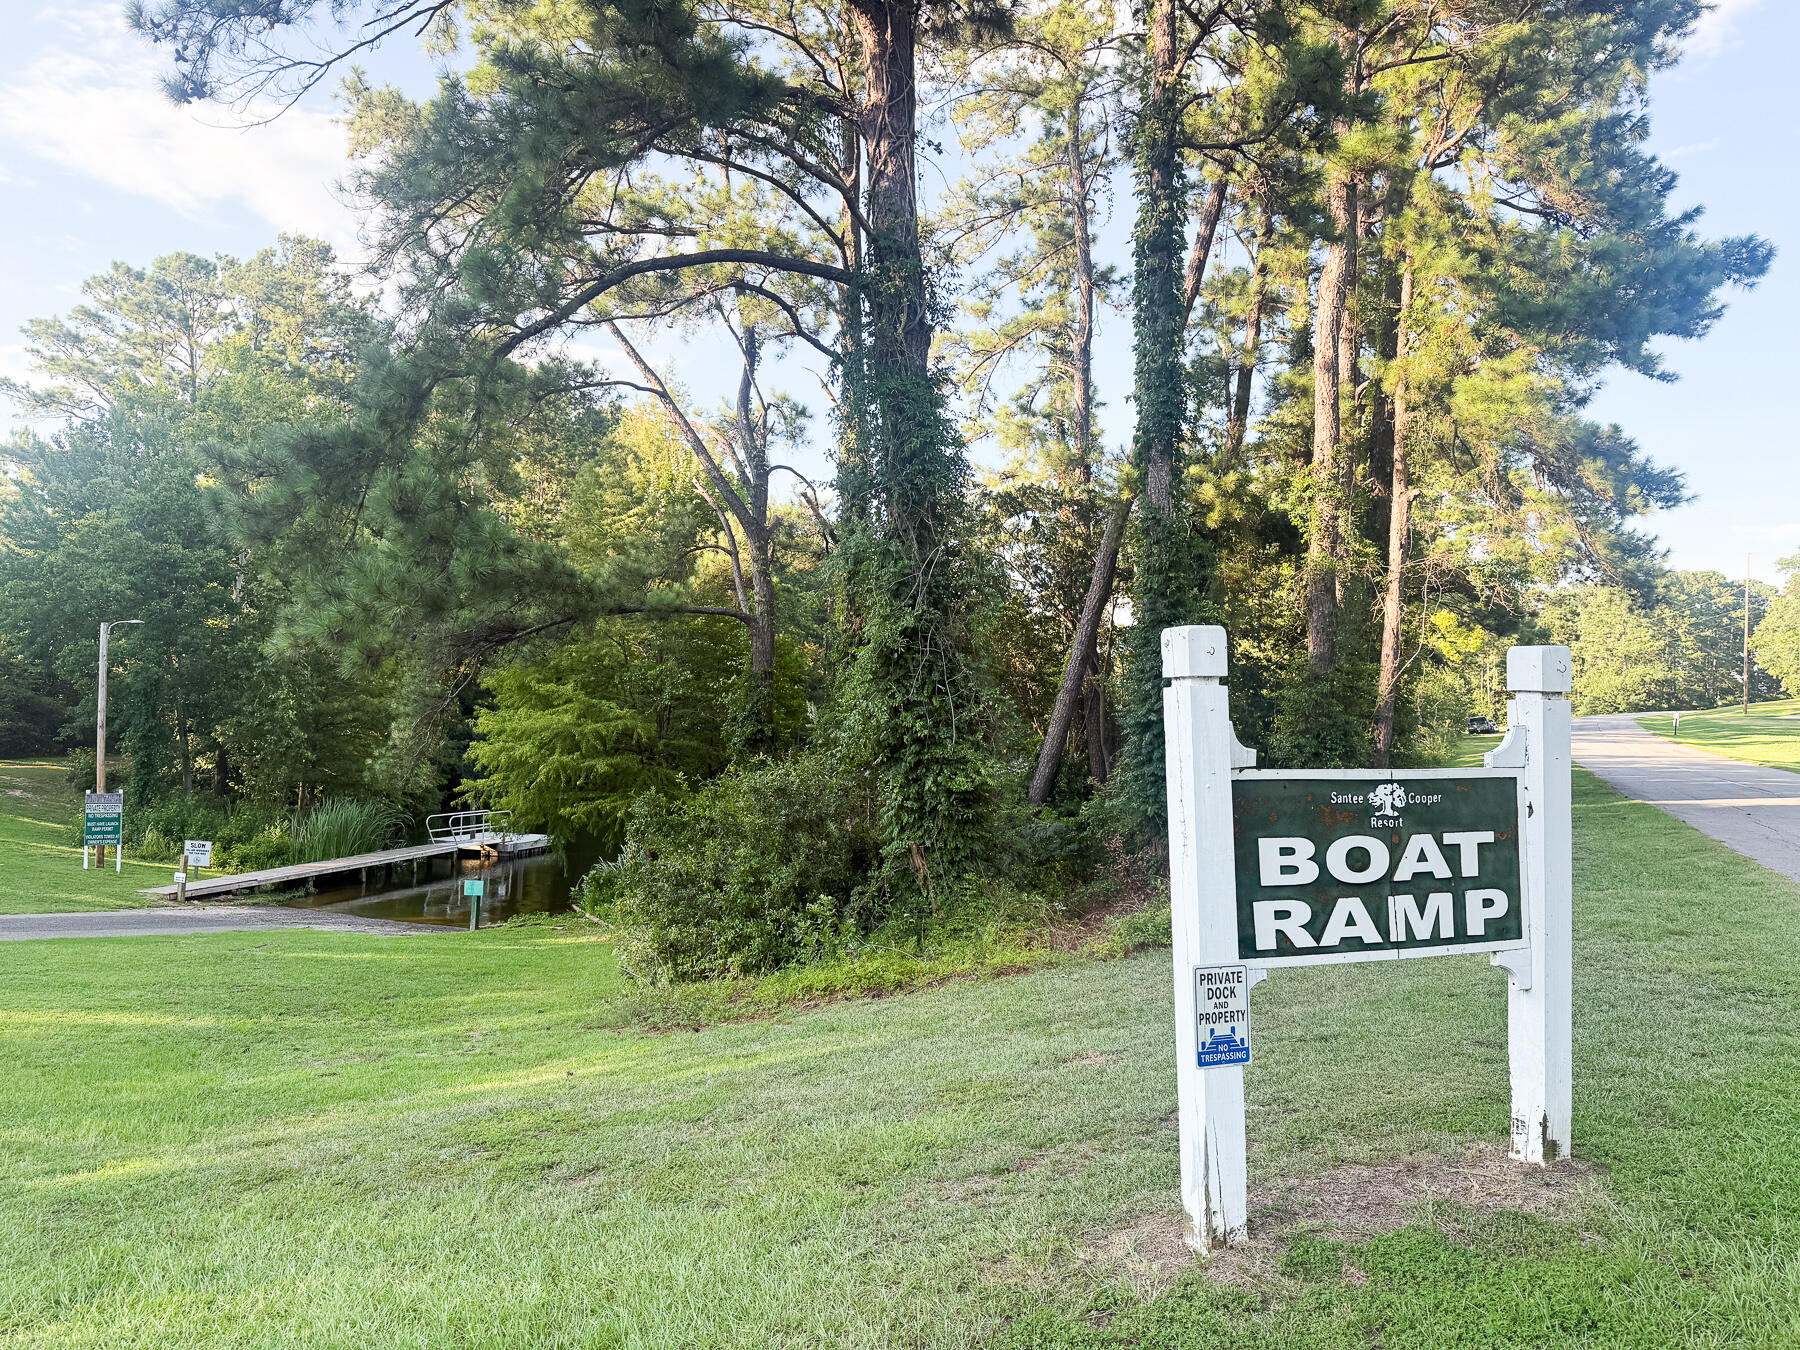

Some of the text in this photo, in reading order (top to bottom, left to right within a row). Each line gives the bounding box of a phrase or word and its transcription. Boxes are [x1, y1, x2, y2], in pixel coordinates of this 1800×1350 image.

[1330, 791, 1442, 806] Santee Cooper
[1370, 817, 1403, 828] Resort
[1257, 830, 1495, 887] BOAT
[1252, 888, 1509, 951] RAMP
[1199, 971, 1243, 986] PRIVATE
[1207, 986, 1237, 1001] DOCK
[1213, 1001, 1229, 1010] AND
[1199, 1010, 1246, 1025] PROPERTY
[1218, 1043, 1229, 1052] NO
[1200, 1051, 1247, 1063] TRESPASSING
